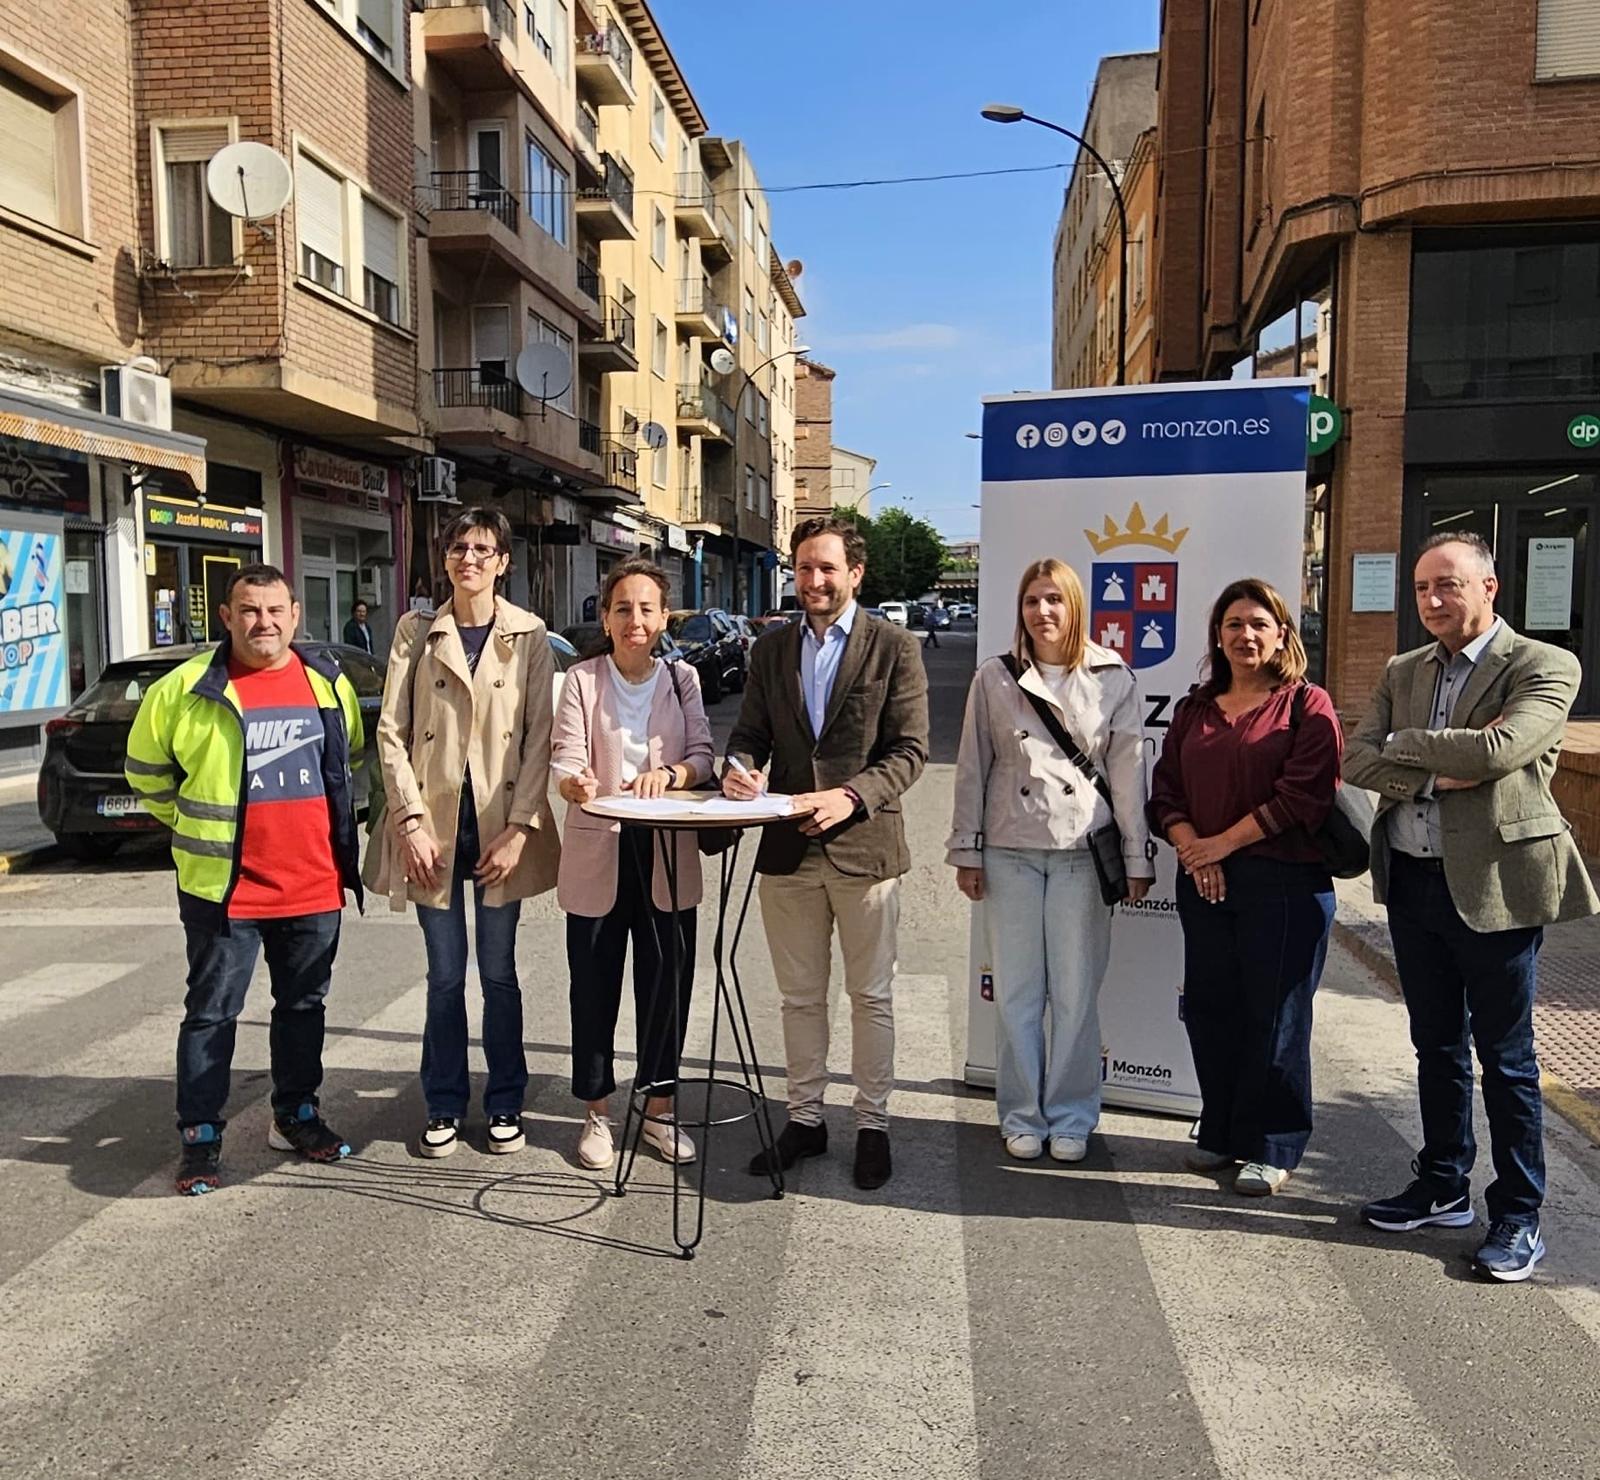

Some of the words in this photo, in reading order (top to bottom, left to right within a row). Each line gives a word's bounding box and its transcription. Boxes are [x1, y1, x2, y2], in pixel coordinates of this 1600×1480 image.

[1142, 418, 1271, 439] monzon.es
[1306, 411, 1335, 443] p
[1572, 421, 1599, 442] dp
[0, 601, 60, 644] BER
[0, 640, 33, 670] OP
[246, 719, 304, 750] NIKE
[106, 796, 138, 811] 6601
[1112, 1060, 1172, 1079] Monzón
[1113, 1072, 1172, 1088] Ayuntamiento
